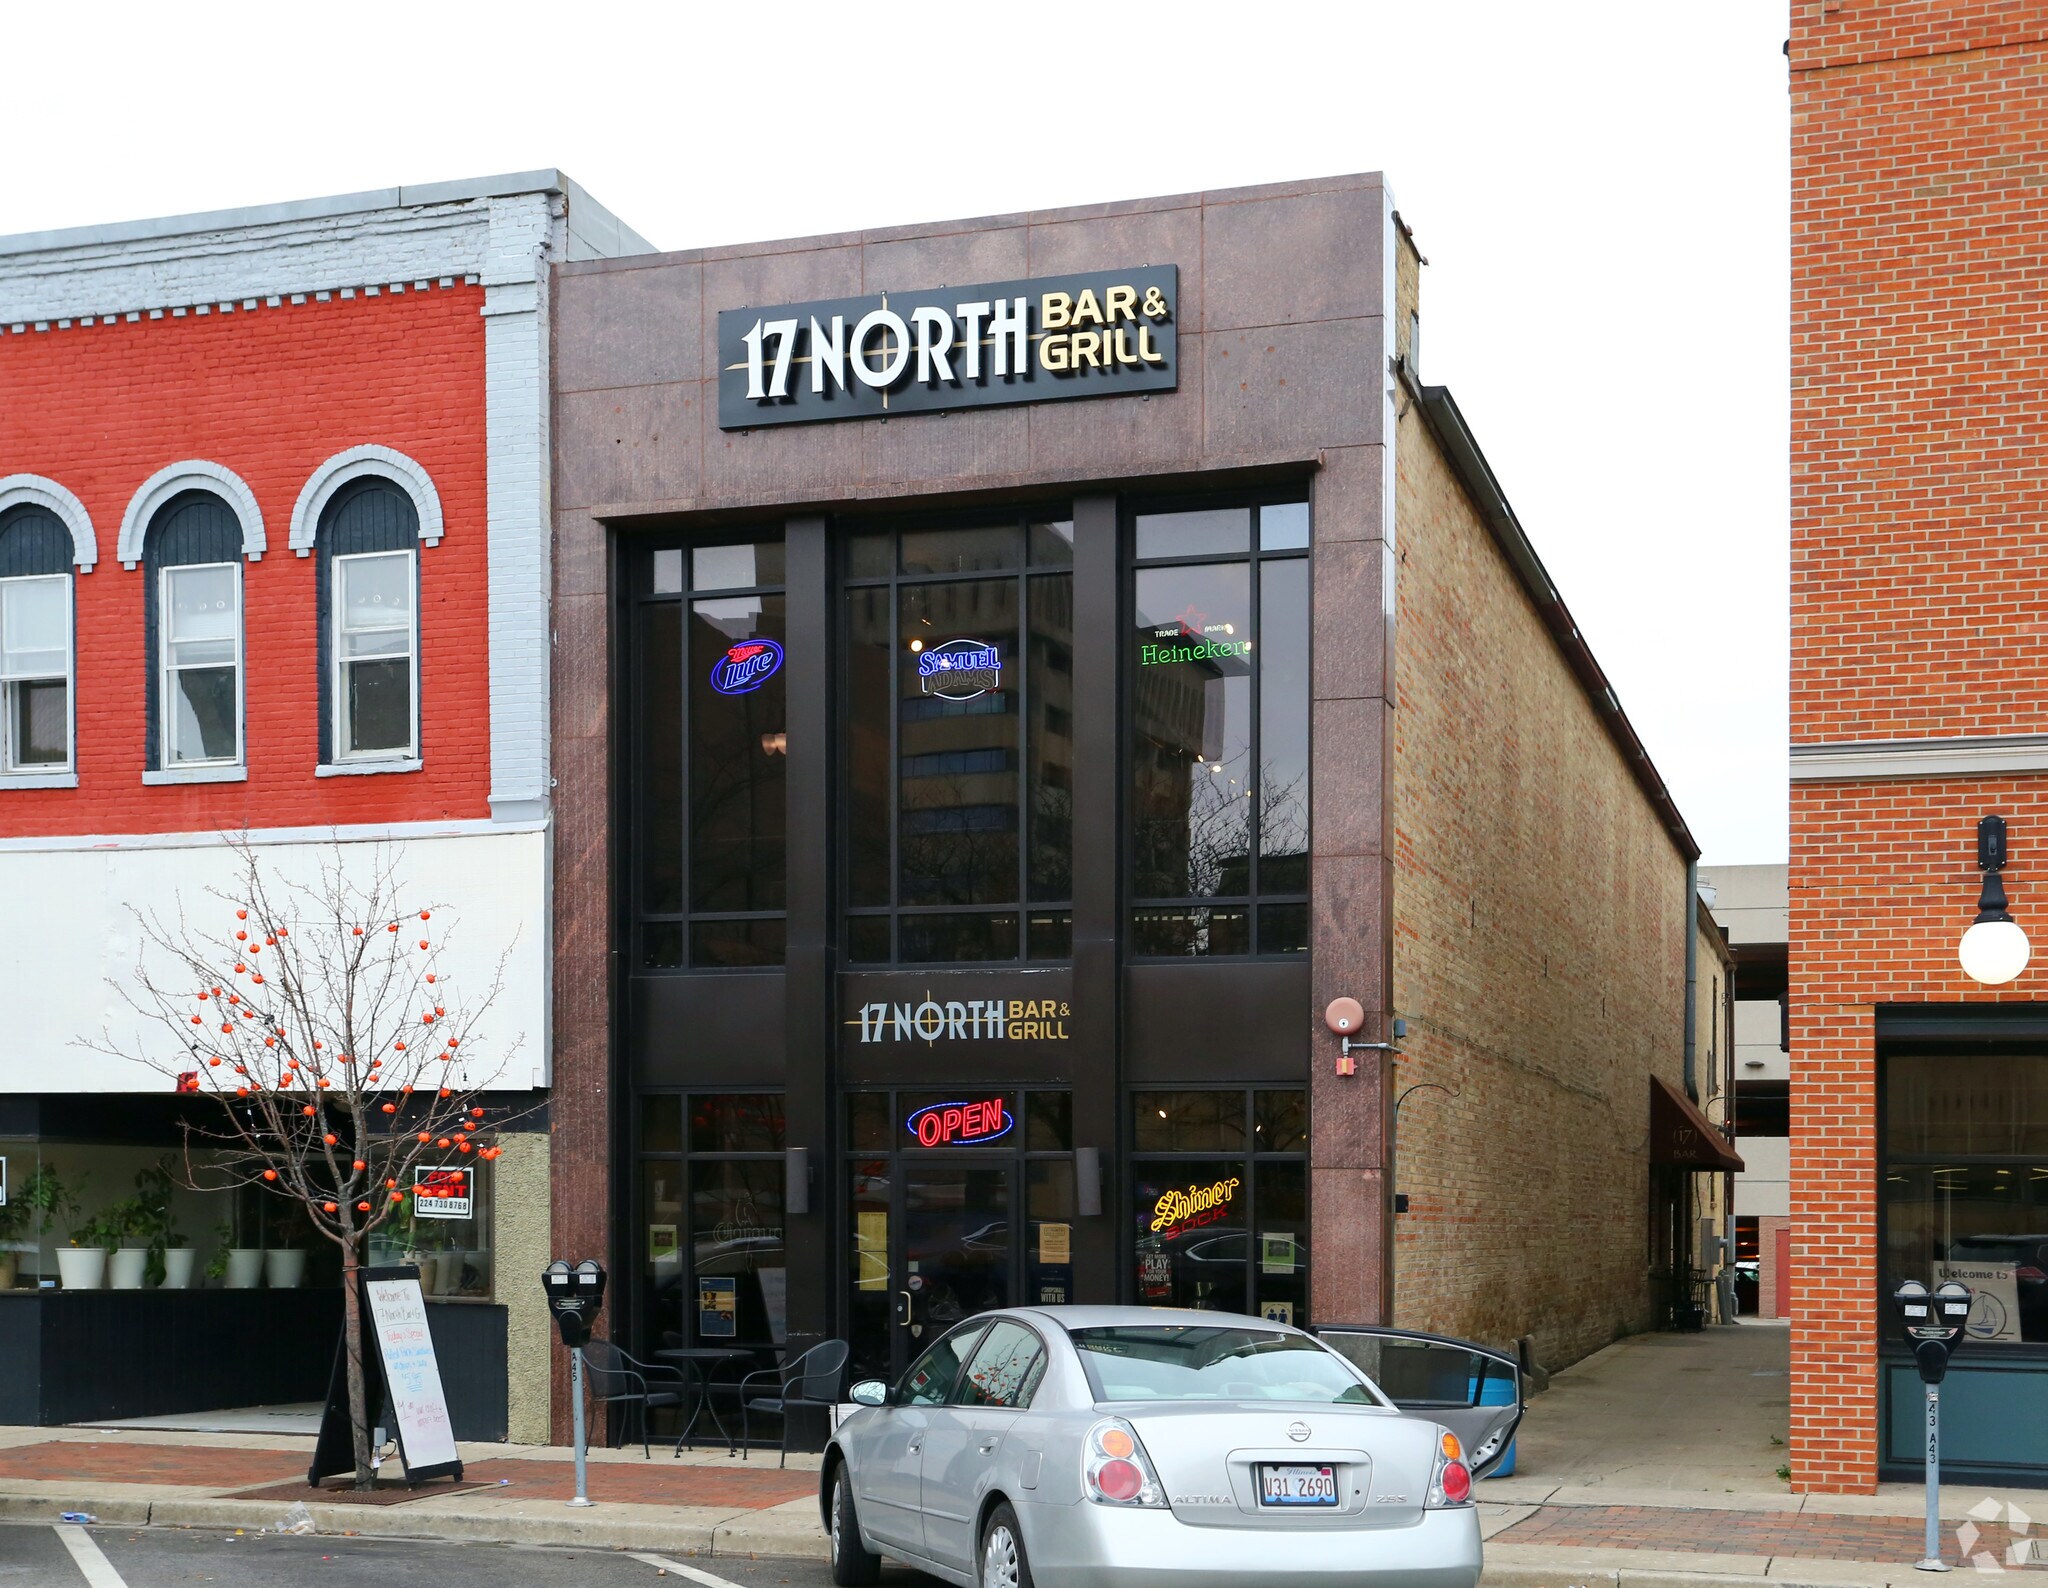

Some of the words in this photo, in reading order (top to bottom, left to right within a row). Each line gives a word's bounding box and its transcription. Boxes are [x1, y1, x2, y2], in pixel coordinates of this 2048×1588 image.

[1041, 285, 1137, 331] BAR
[1144, 286, 1168, 318] &
[741, 318, 798, 399] 17
[811, 296, 1028, 394] NORTH
[1038, 328, 1163, 373] GRILL
[1154, 628, 1180, 638] TRADE
[919, 646, 1002, 676] SAMUEL
[1141, 639, 1250, 666] Heineken
[723, 652, 774, 690] Lite
[926, 668, 995, 697] ADAMS
[1008, 1000, 1057, 1019] BAR
[1059, 1002, 1071, 1017] &
[858, 1001, 888, 1043] 17
[894, 1000, 1004, 1042] NORTH
[1008, 1021, 1069, 1041] GRILL
[918, 1098, 1002, 1147] OPEN
[428, 1171, 459, 1184] FO
[422, 1184, 467, 1197] ENT
[420, 1199, 433, 1208] 224
[434, 1200, 448, 1209] 730
[448, 1201, 467, 1210] 8768
[1150, 1177, 1240, 1231] Shiner
[1166, 1204, 1228, 1240] BOCK
[1145, 1259, 1169, 1270] PLAY
[1938, 1268, 1994, 1280] Welcome
[1996, 1270, 2008, 1280] to
[1144, 1273, 1170, 1282] MONEY!
[1041, 1293, 1056, 1303] WITH
[1057, 1293, 1065, 1303] US
[1286, 1467, 1317, 1476] Illinois
[1265, 1477, 1291, 1497] V31
[1298, 1477, 1333, 1497] 2690
[1172, 1494, 1232, 1505] ALTIMA
